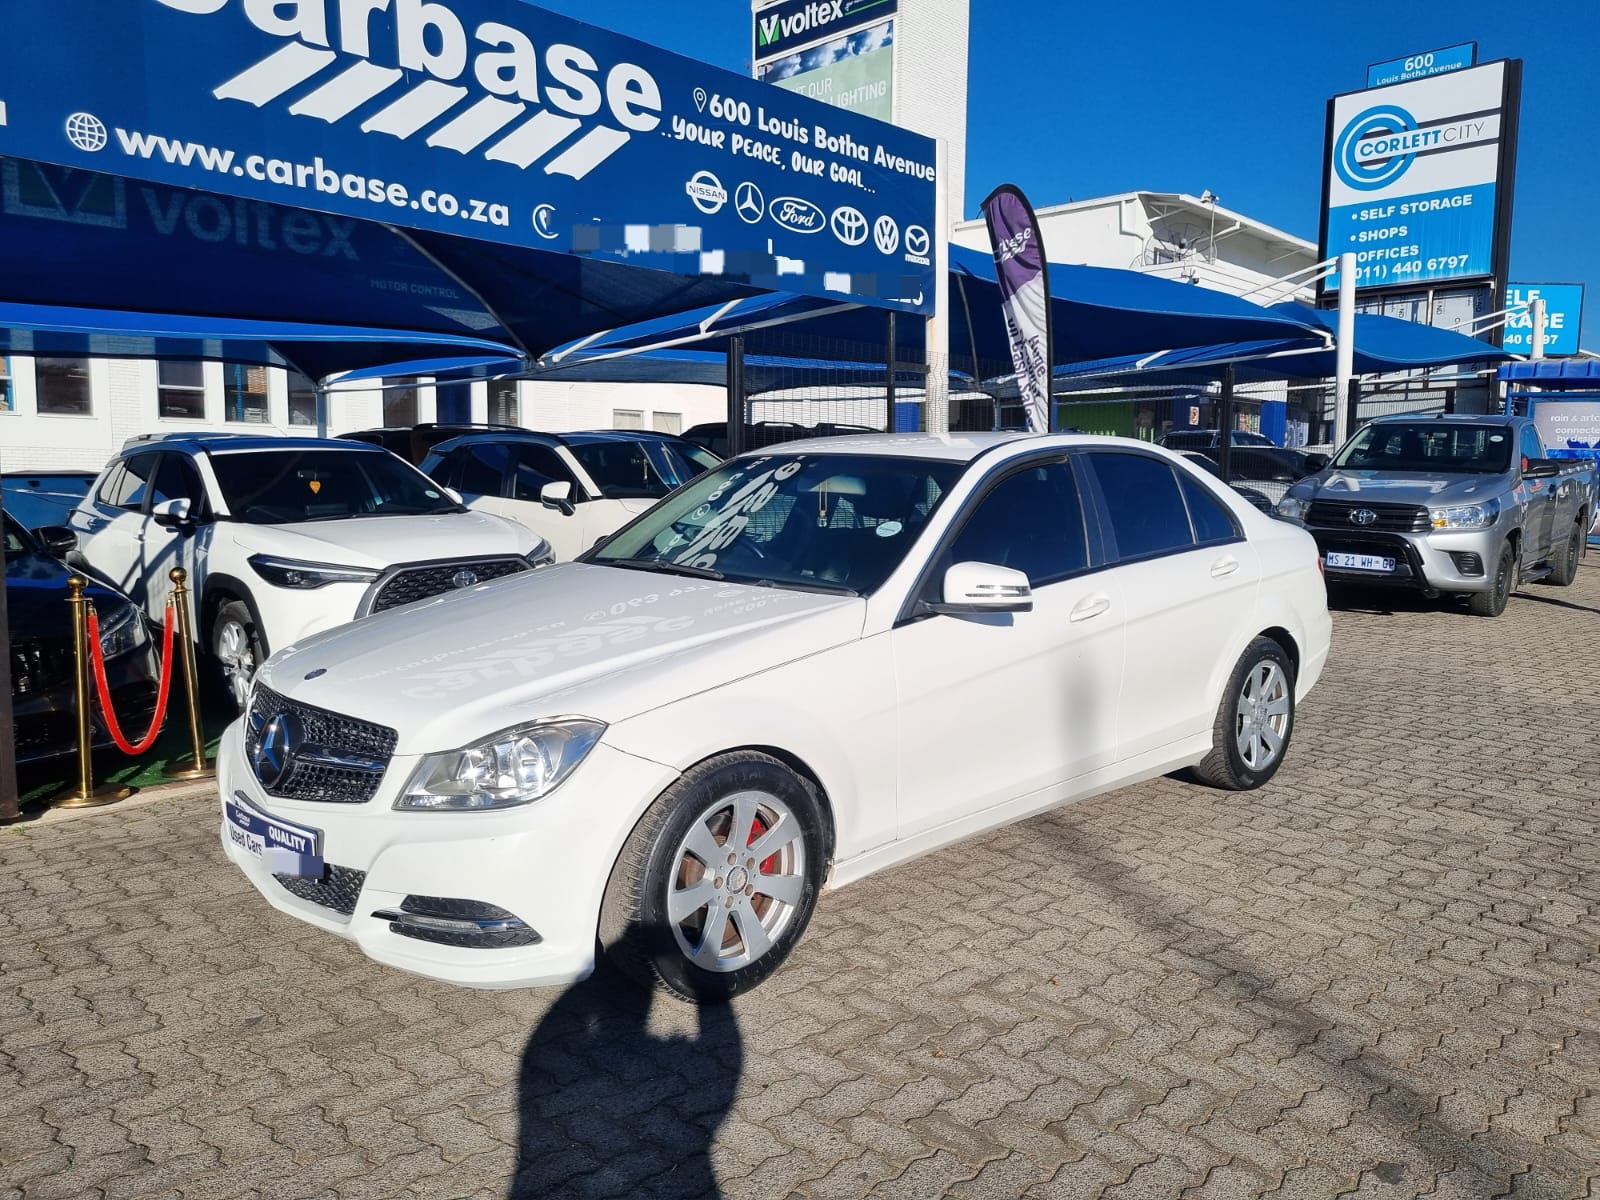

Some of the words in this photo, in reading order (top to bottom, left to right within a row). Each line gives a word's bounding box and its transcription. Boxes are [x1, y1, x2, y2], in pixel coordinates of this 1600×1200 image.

[781, 0, 843, 38] voltex
[155, 0, 662, 131] arbase
[1376, 73, 1399, 85] Louis
[1401, 69, 1426, 80] Botha
[1428, 61, 1462, 74] Avenue
[1404, 53, 1434, 71] 600
[808, 78, 832, 97] OUR
[709, 94, 751, 126] 600
[757, 106, 808, 144] Louis
[814, 125, 869, 162] Botha
[873, 145, 935, 182] Avenue
[732, 133, 787, 170] PEACE,
[115, 127, 509, 227] www.carbase.co.za
[689, 183, 726, 200] NISSAN
[780, 201, 816, 228] Ford
[1360, 206, 1396, 221] SELF
[1400, 194, 1473, 215] STORAGE
[140, 180, 359, 261] voltex
[1358, 226, 1408, 242] SHOPS
[1355, 265, 1388, 280] 011)
[1392, 260, 1422, 276] 440
[1427, 254, 1469, 271] 6797
[1357, 245, 1419, 263] OFFICES
[1550, 413, 1569, 422] rain
[1344, 556, 1356, 566] 21
[1361, 557, 1374, 568] WH
[1382, 559, 1395, 569] GP
[229, 823, 246, 847] Used
[246, 833, 263, 858] Cars
[268, 825, 307, 852] QUALITY
